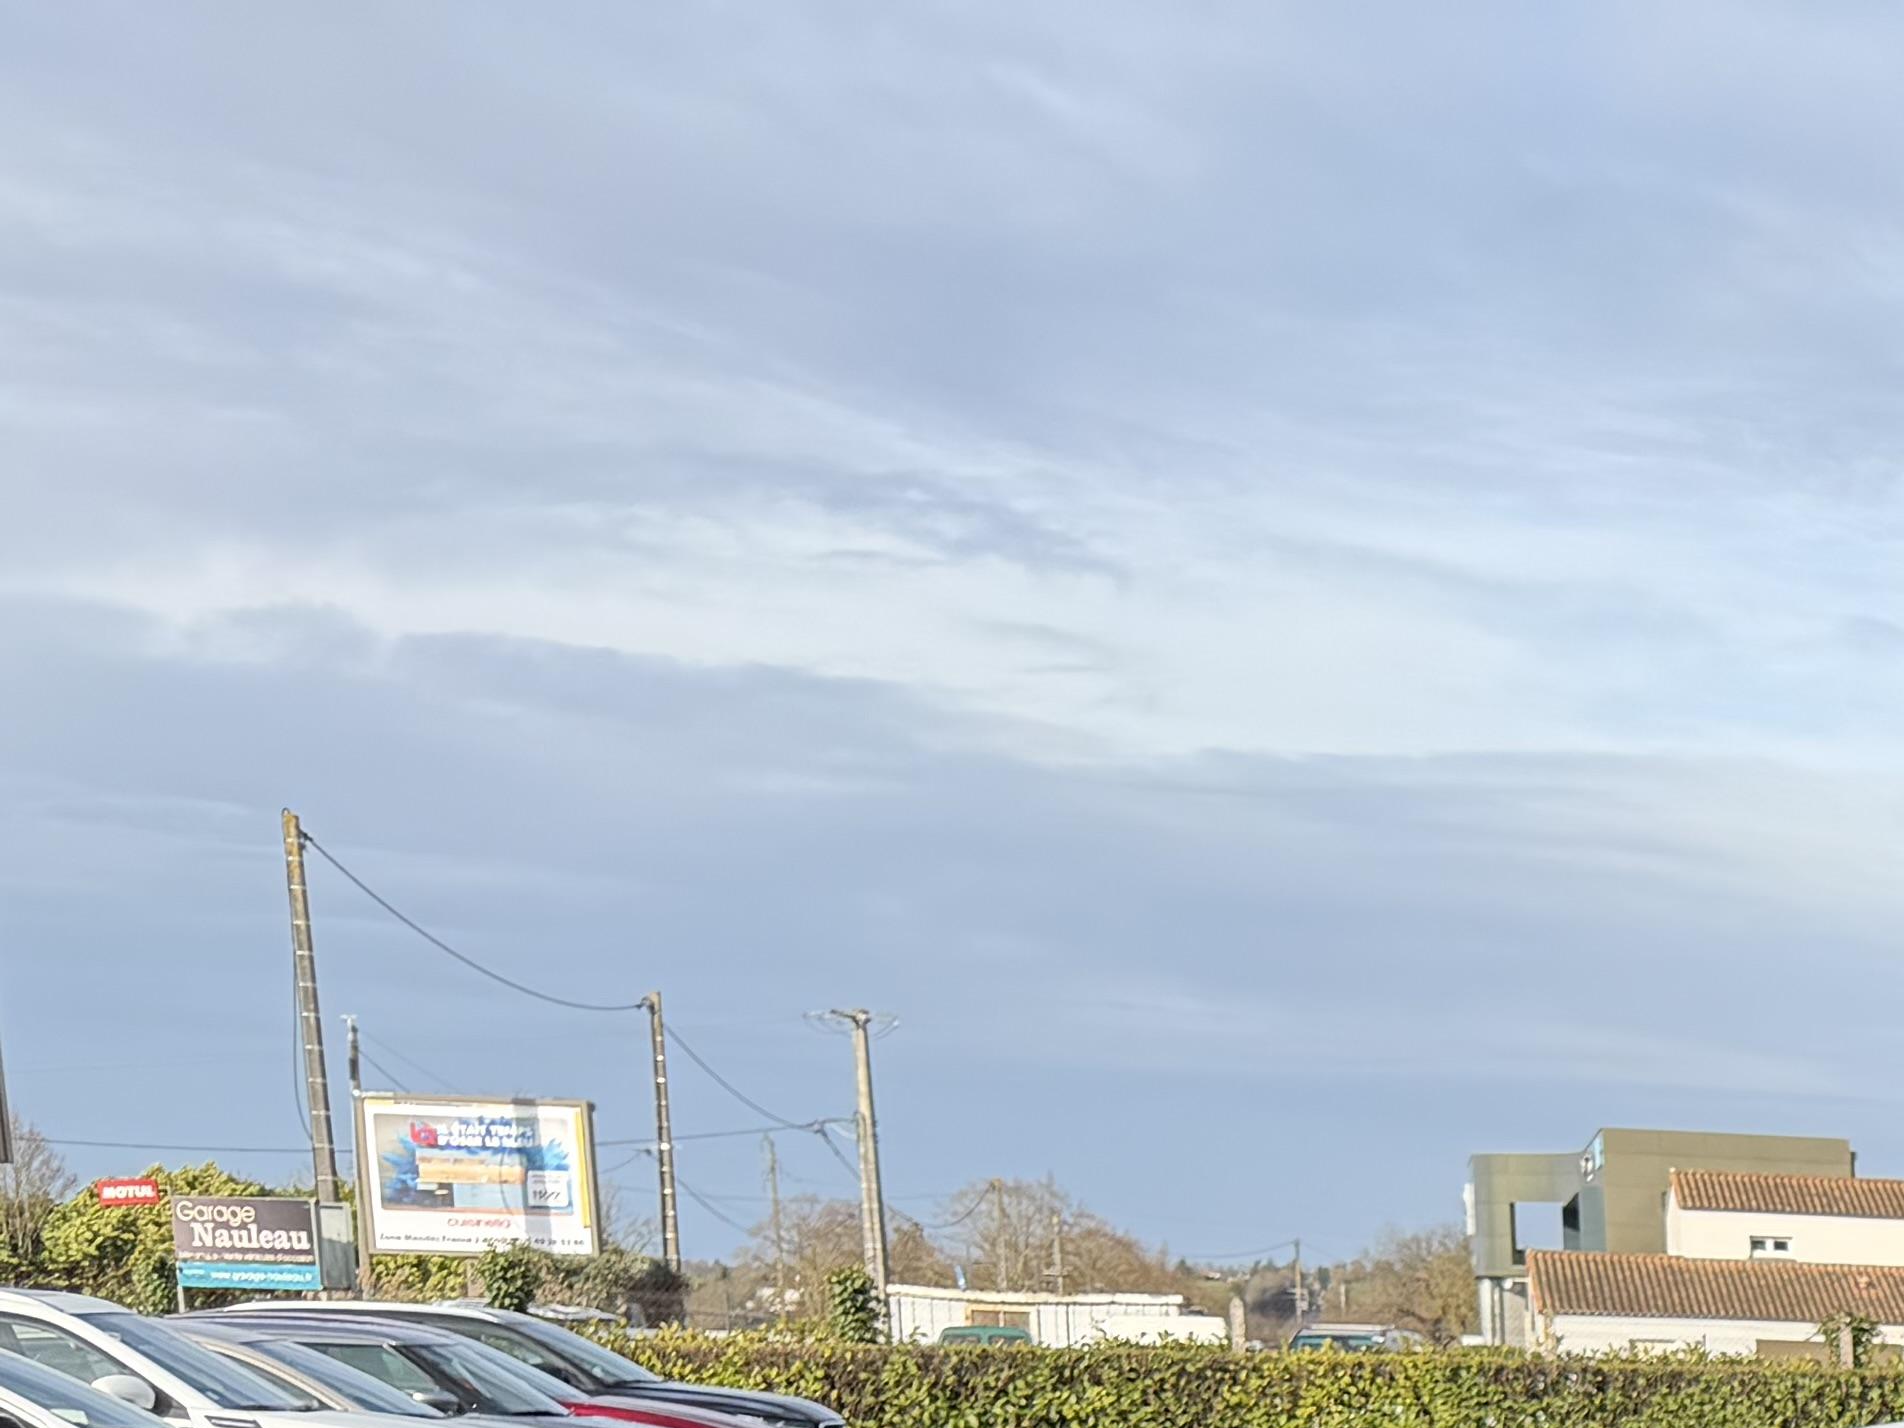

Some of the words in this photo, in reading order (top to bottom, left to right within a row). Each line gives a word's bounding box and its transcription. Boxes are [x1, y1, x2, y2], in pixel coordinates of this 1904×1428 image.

[102, 1185, 157, 1200] MOTUL
[175, 1200, 256, 1227] Garage
[190, 1222, 312, 1250] Nauleau
